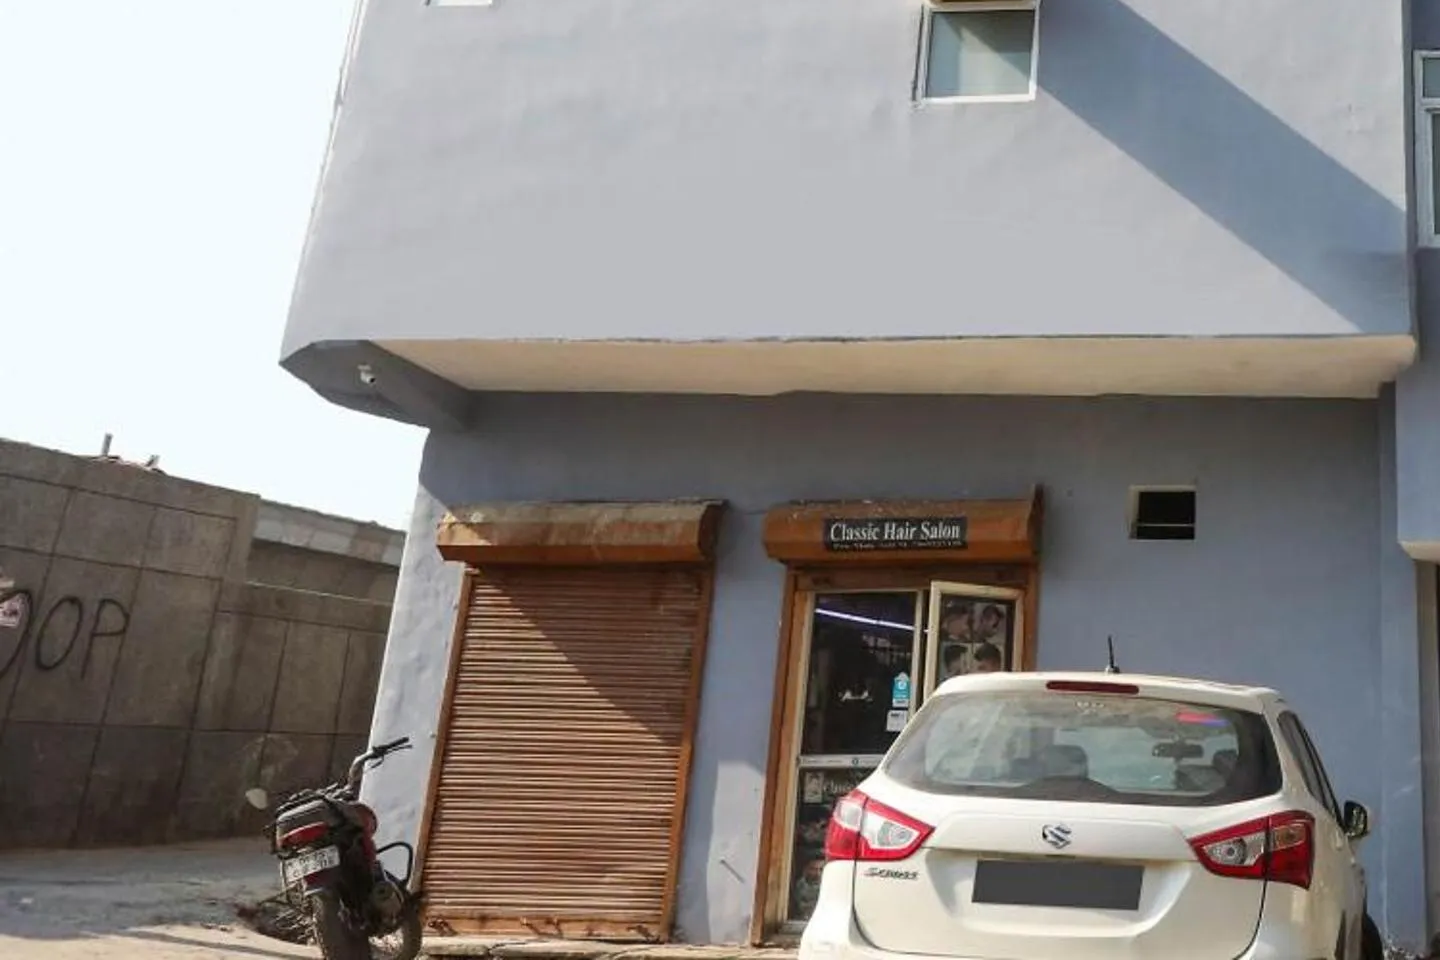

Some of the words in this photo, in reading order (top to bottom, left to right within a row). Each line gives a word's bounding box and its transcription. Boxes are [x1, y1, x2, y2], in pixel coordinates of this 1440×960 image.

[830, 521, 880, 541] Classic
[884, 521, 917, 540] Hair
[920, 520, 960, 540] Salon
